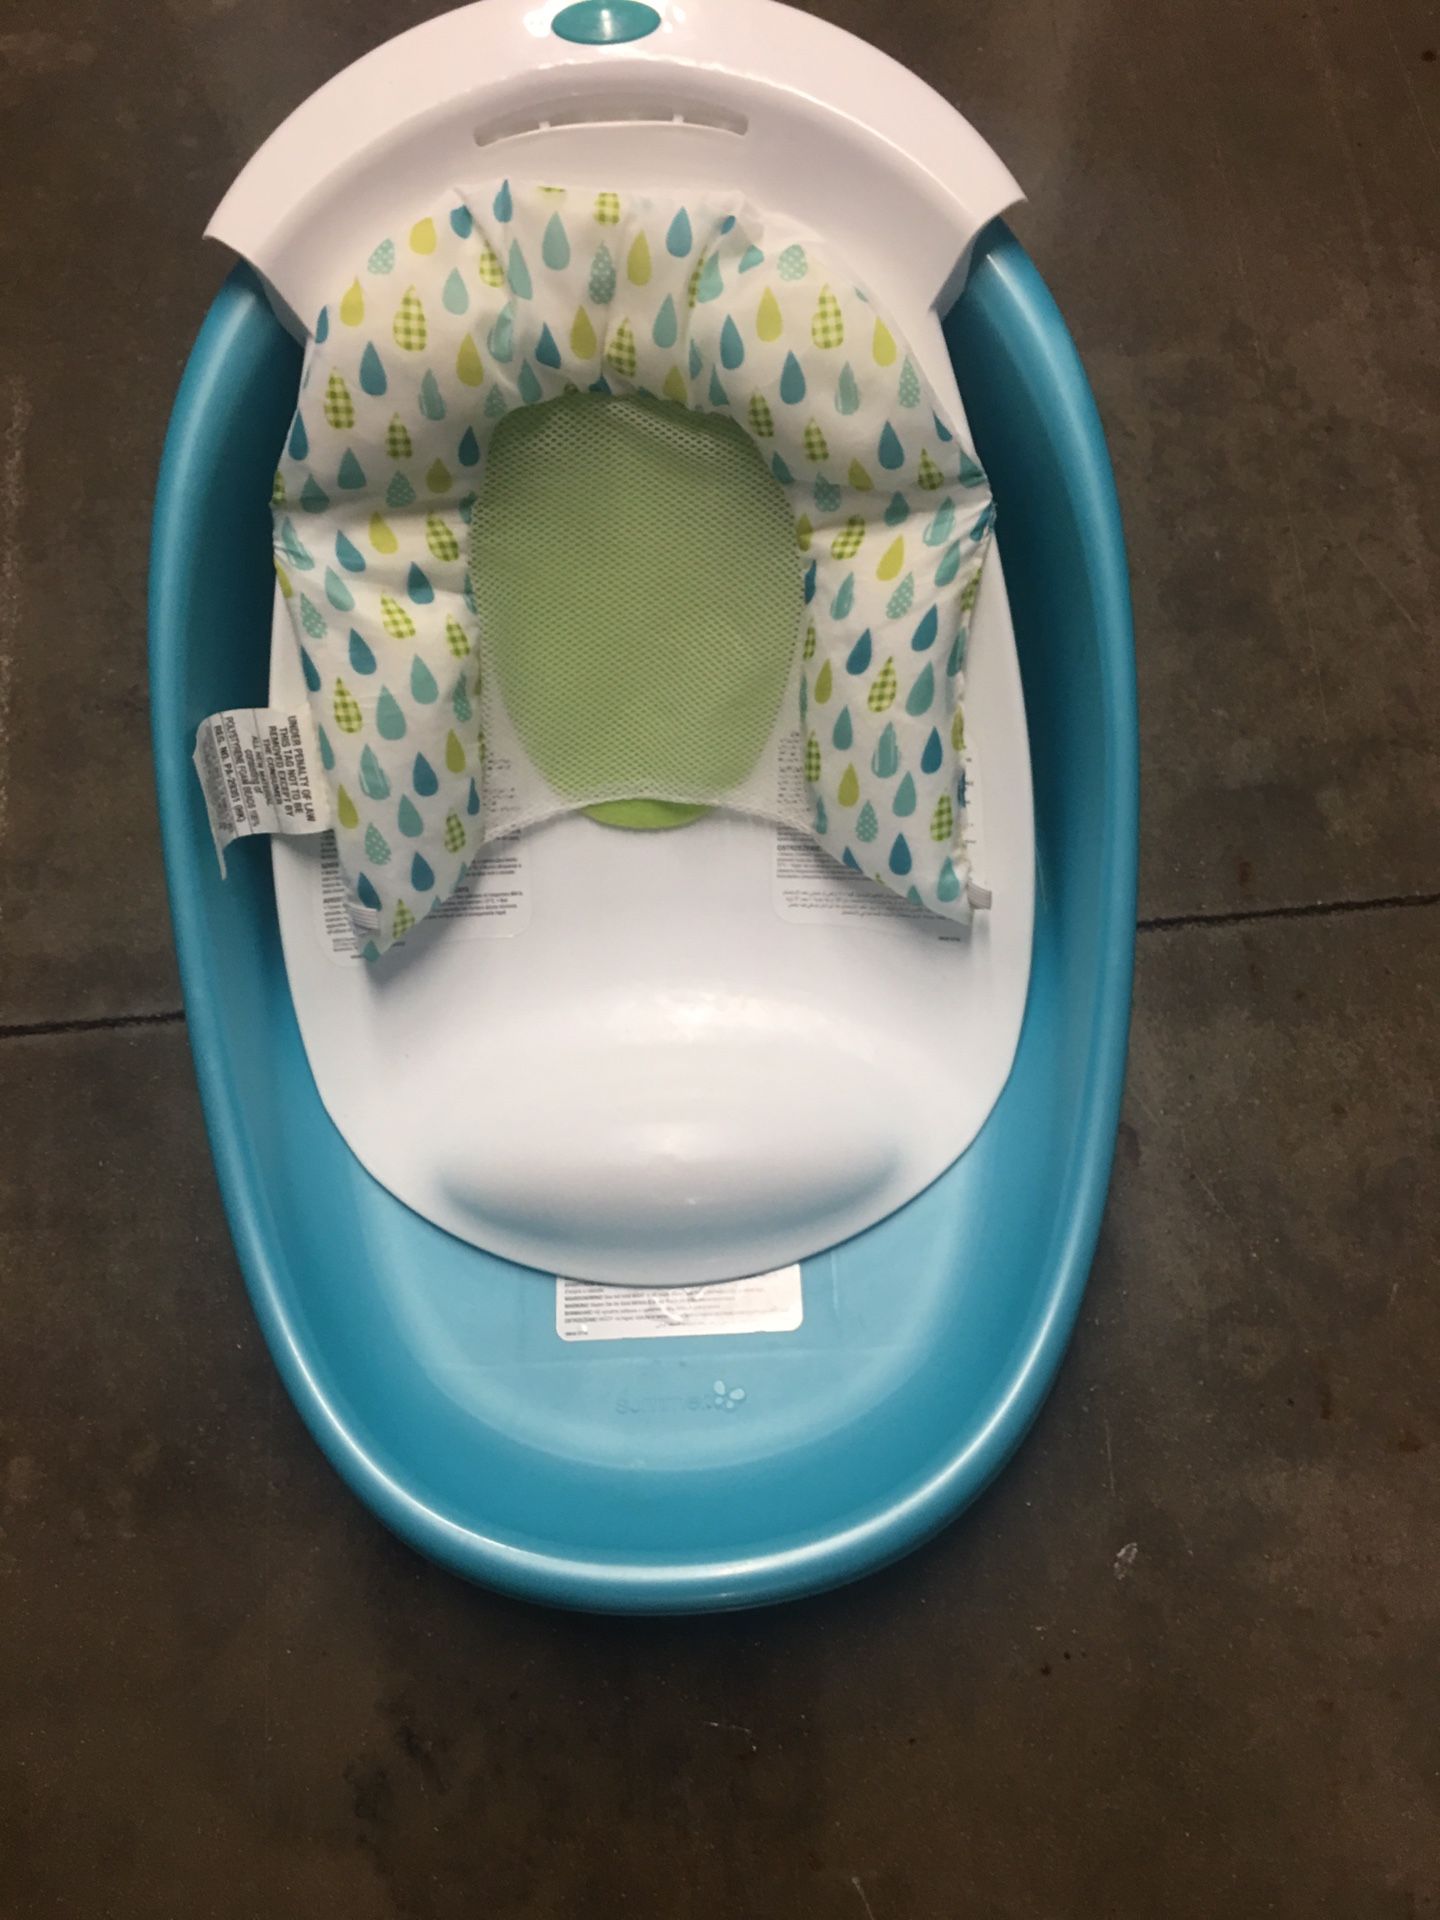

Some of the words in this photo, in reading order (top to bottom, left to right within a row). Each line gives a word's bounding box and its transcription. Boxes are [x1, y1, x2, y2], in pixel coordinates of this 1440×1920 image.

[279, 726, 291, 747] THIS
[288, 715, 302, 746] UNDER
[263, 738, 272, 754] THE
[268, 725, 284, 768] REMOVED
[284, 749, 295, 767] TAG
[294, 748, 309, 787] PENALTY
[267, 757, 282, 805] CONSUMER
[278, 770, 291, 802] EXCEPT
[287, 769, 298, 786] NOT
[291, 789, 301, 800] TO
[301, 789, 312, 800] OF
[284, 805, 295, 817] BY
[294, 802, 303, 813] BE
[304, 802, 316, 821] LAW
